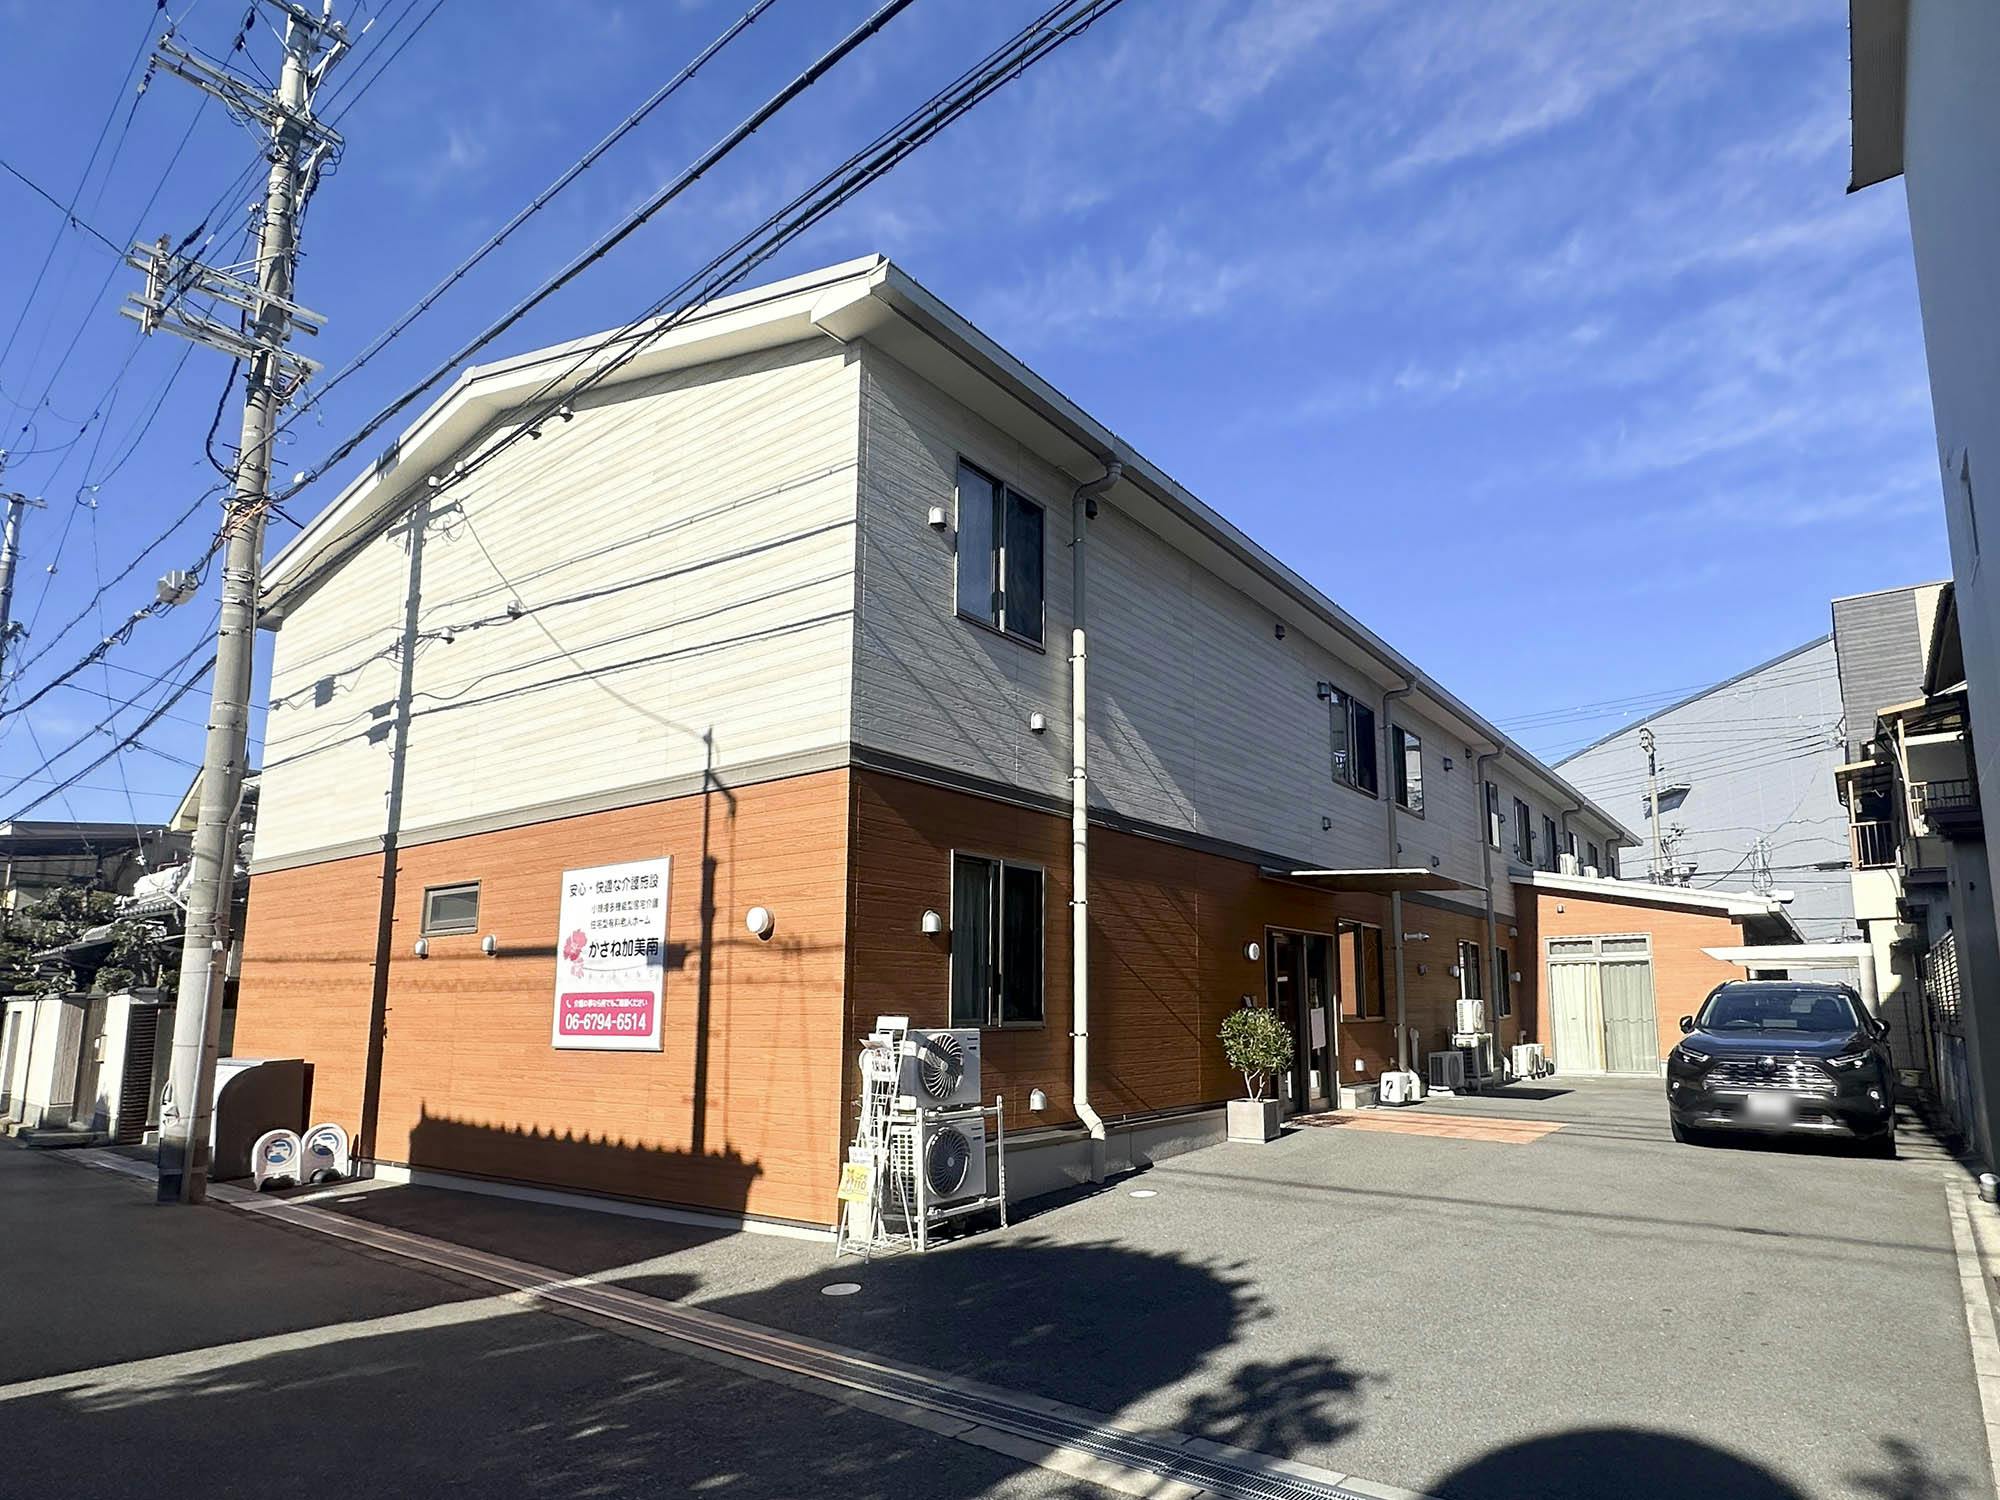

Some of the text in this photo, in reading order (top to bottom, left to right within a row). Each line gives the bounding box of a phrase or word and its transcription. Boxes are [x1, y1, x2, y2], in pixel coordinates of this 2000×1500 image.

[569, 873, 659, 898] 安心・快適な介護施設
[588, 937, 659, 958] かさね加美南
[565, 1012, 646, 1031] 06-6794-6514
